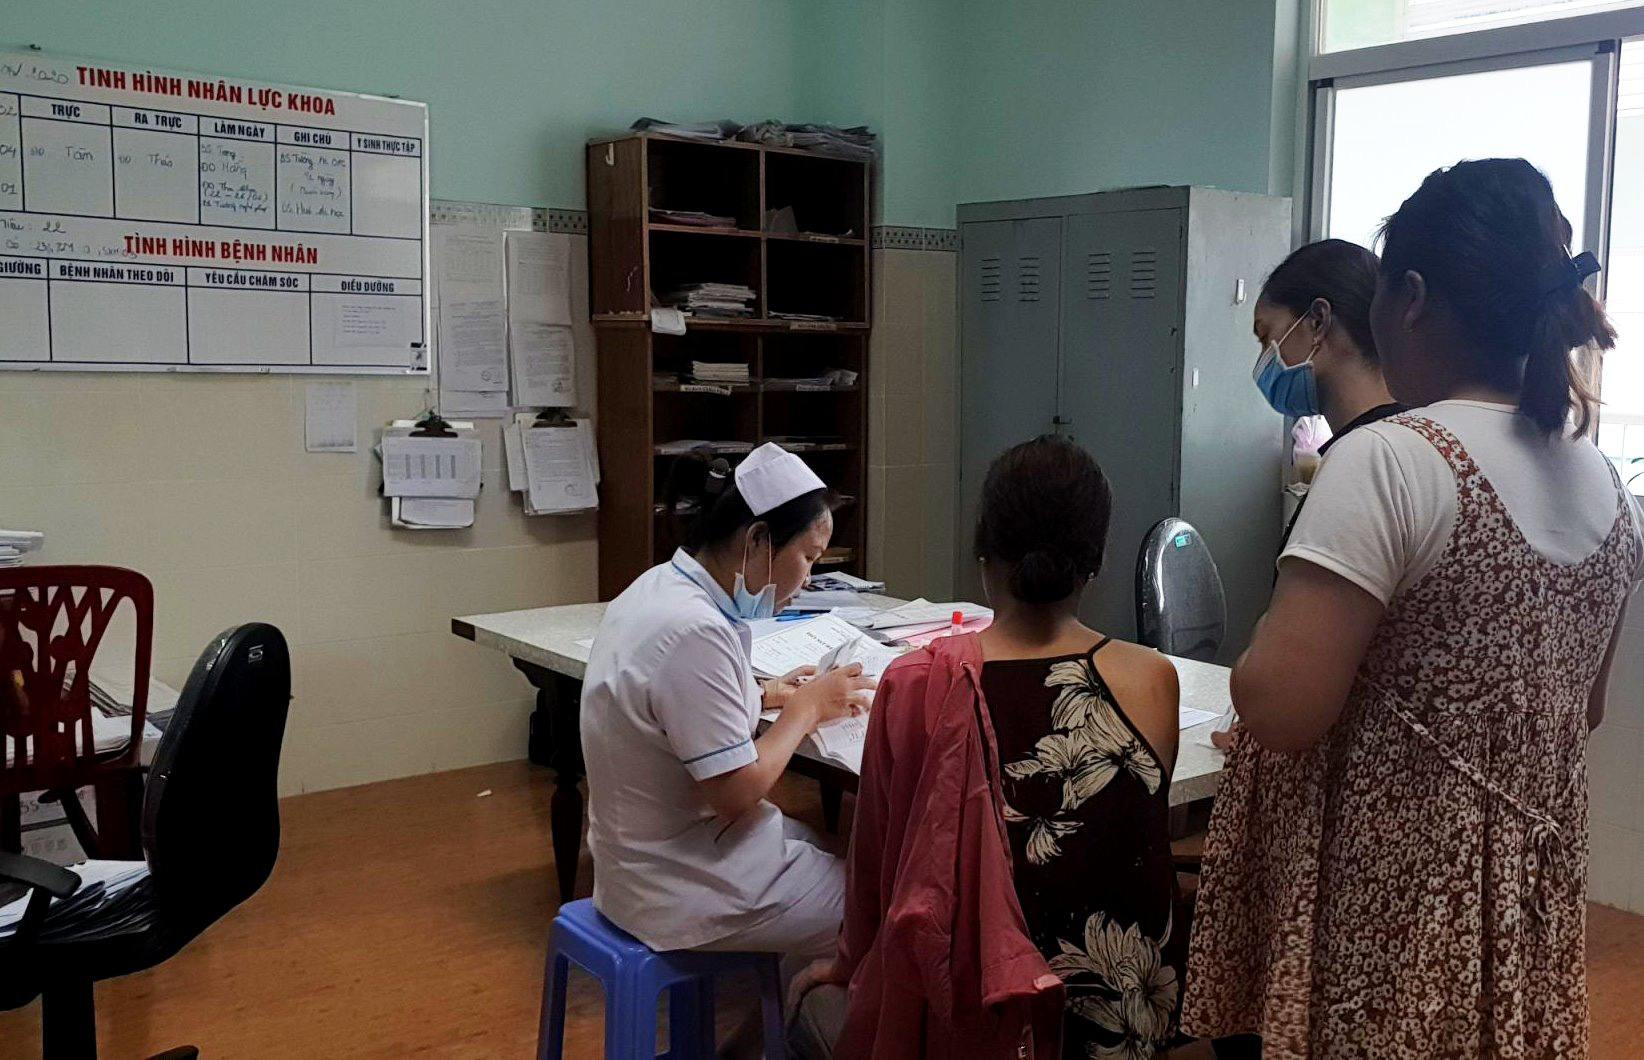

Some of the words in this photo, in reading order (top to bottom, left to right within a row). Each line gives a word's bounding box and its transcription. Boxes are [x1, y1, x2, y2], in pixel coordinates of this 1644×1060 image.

[132, 70, 181, 96] HÌNH
[187, 80, 242, 104] NHÂN
[248, 87, 282, 111] LỰC
[288, 93, 336, 116] KHOA
[51, 103, 81, 119] TRỰC
[134, 112, 149, 125] RA
[154, 114, 182, 131] TRỰC
[214, 120, 236, 135] LÀM
[237, 124, 265, 139] NGÀY
[294, 131, 310, 143] GHI
[312, 131, 331, 145] CHÚ
[363, 138, 381, 150] SINH
[382, 139, 400, 154] THỰC
[401, 141, 415, 153] TẬP
[124, 232, 167, 256] TÌNH
[172, 235, 216, 259] HÌNH
[221, 239, 267, 264] BỆNH
[271, 243, 318, 264] NHÂN
[60, 263, 91, 279] BỆNH
[93, 265, 124, 280] NHÂN
[127, 269, 153, 282] THEO
[205, 270, 225, 284] YÊU
[280, 276, 299, 288] SÓC
